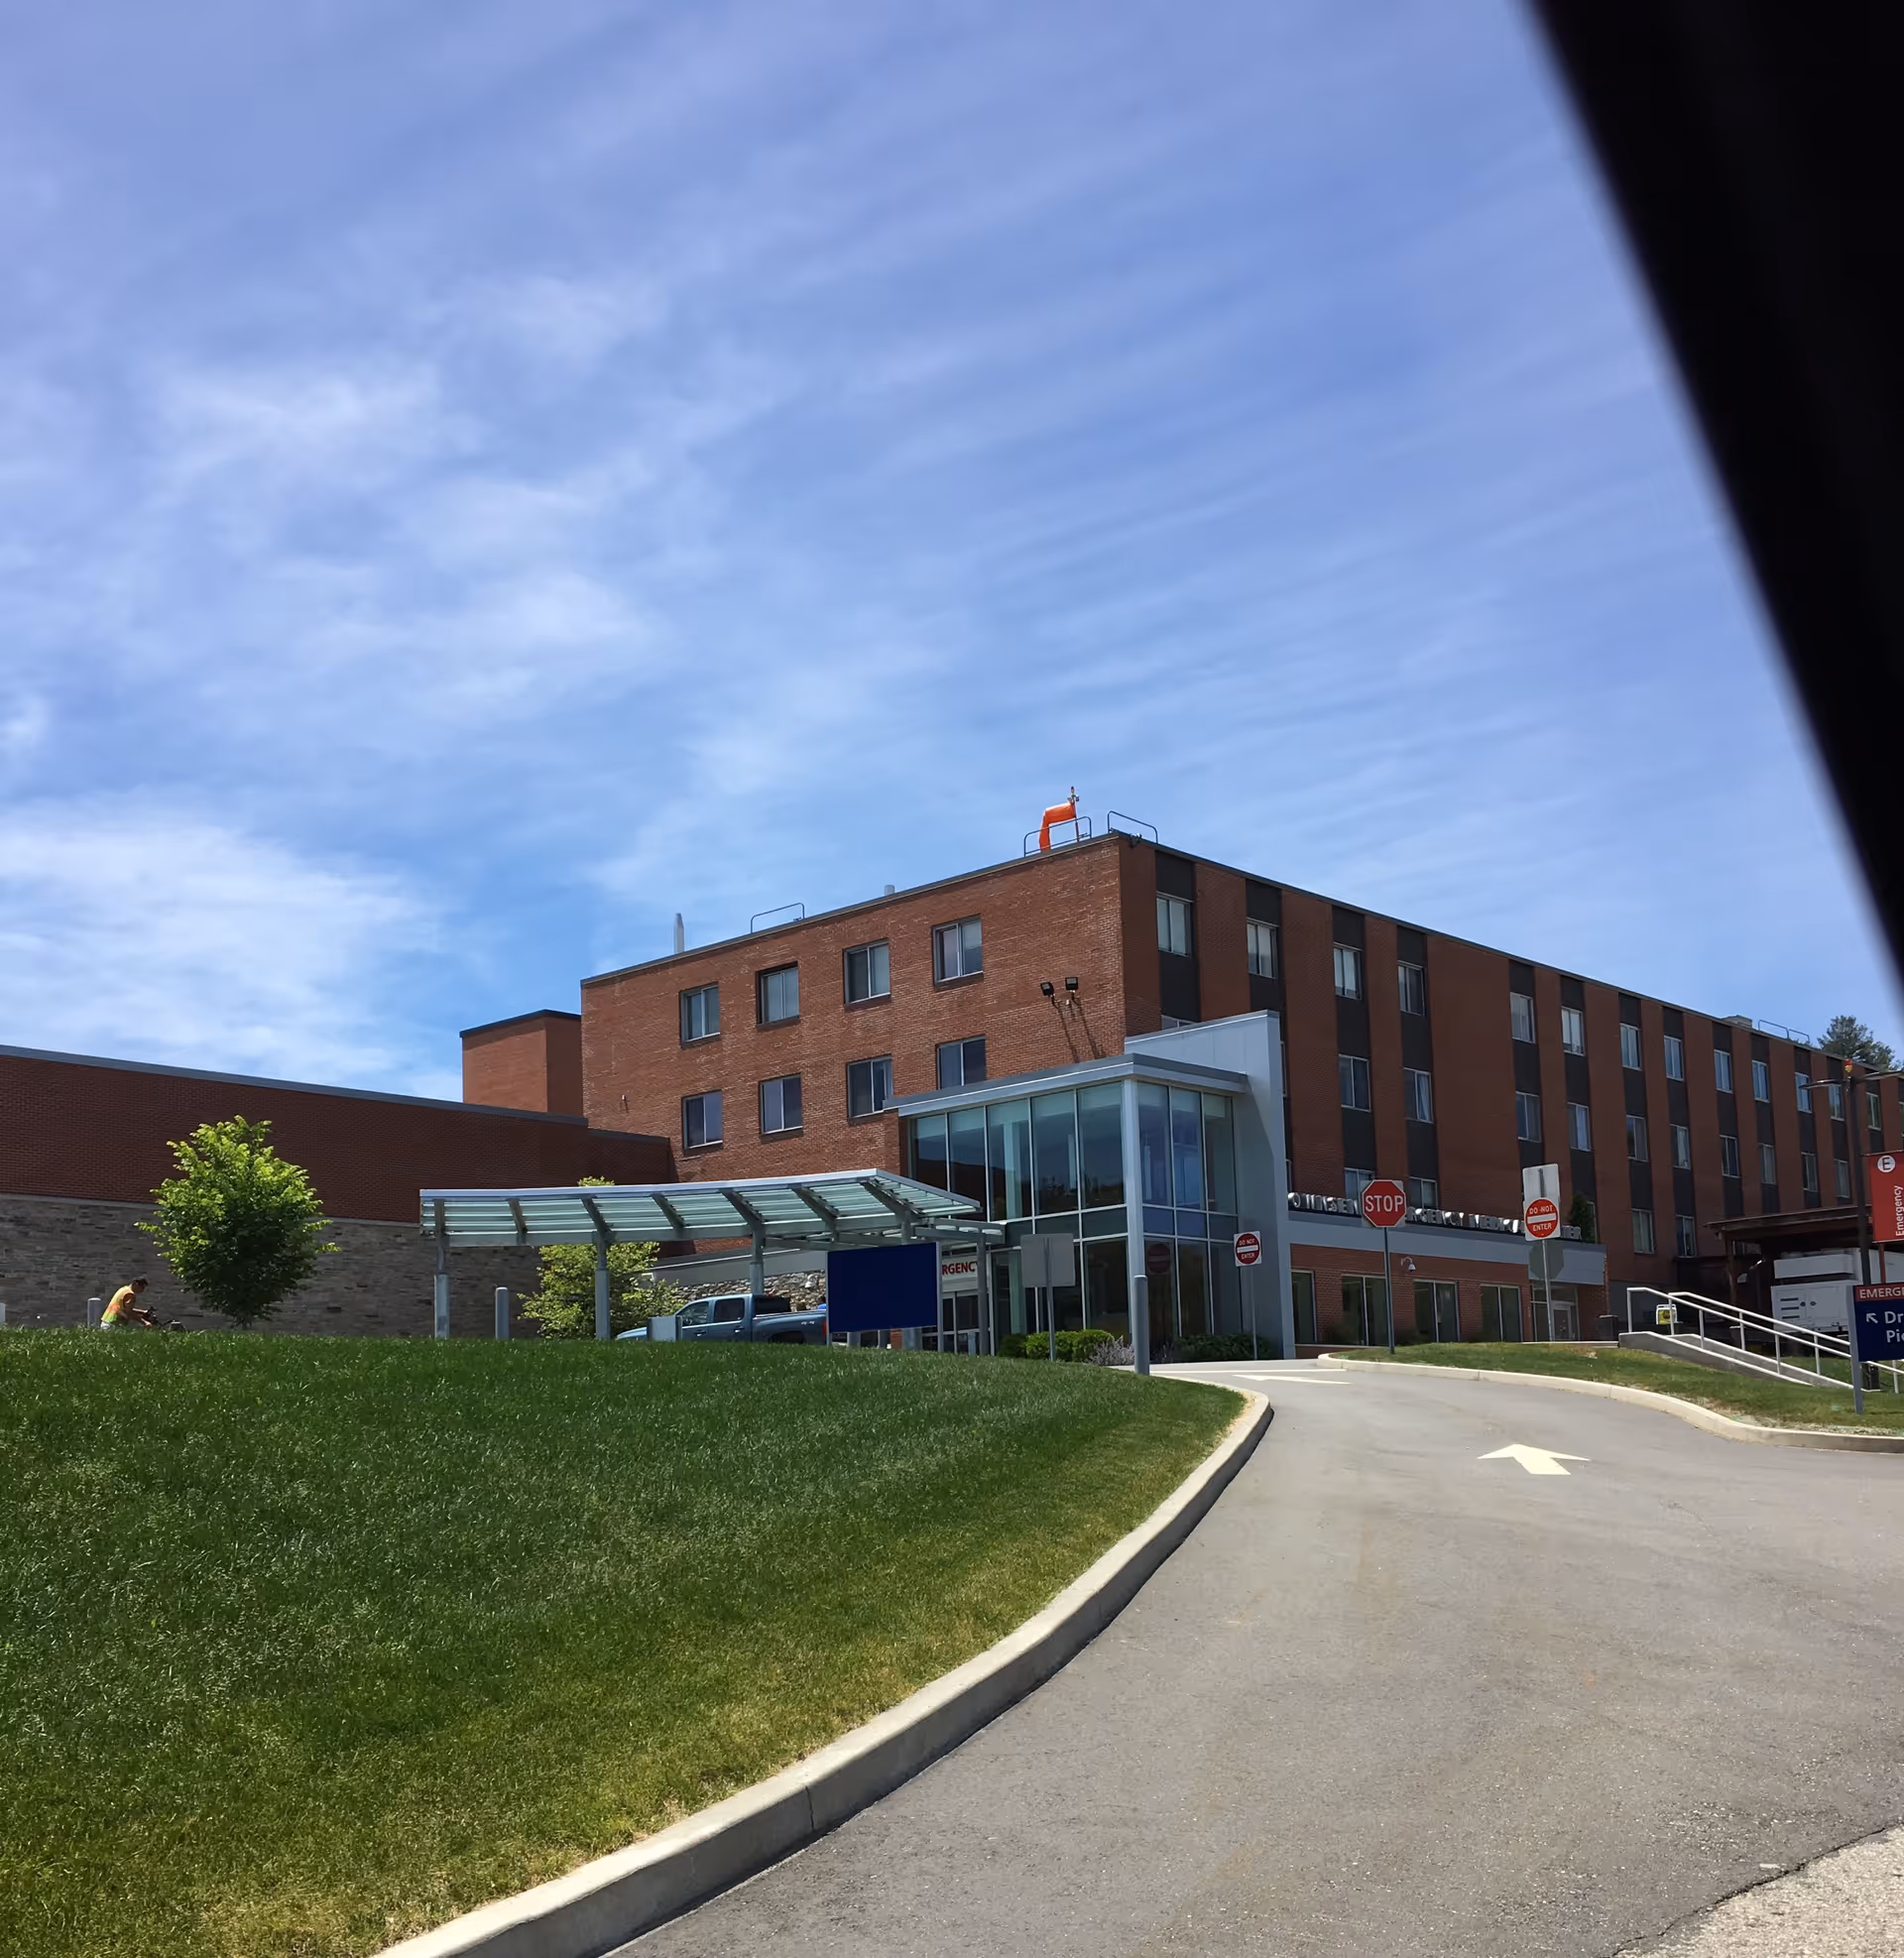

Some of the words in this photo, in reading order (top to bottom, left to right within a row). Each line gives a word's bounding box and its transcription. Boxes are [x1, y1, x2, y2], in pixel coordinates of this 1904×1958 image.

[1882, 1157, 1891, 1170] E
[1366, 1194, 1404, 1212] STOP
[1540, 1204, 1553, 1213] NOT
[1894, 1185, 1904, 1236] Emergency
[1532, 1222, 1552, 1232] ENTER
[942, 1261, 978, 1275] RGENC
[1859, 1286, 1904, 1299] EMERG
